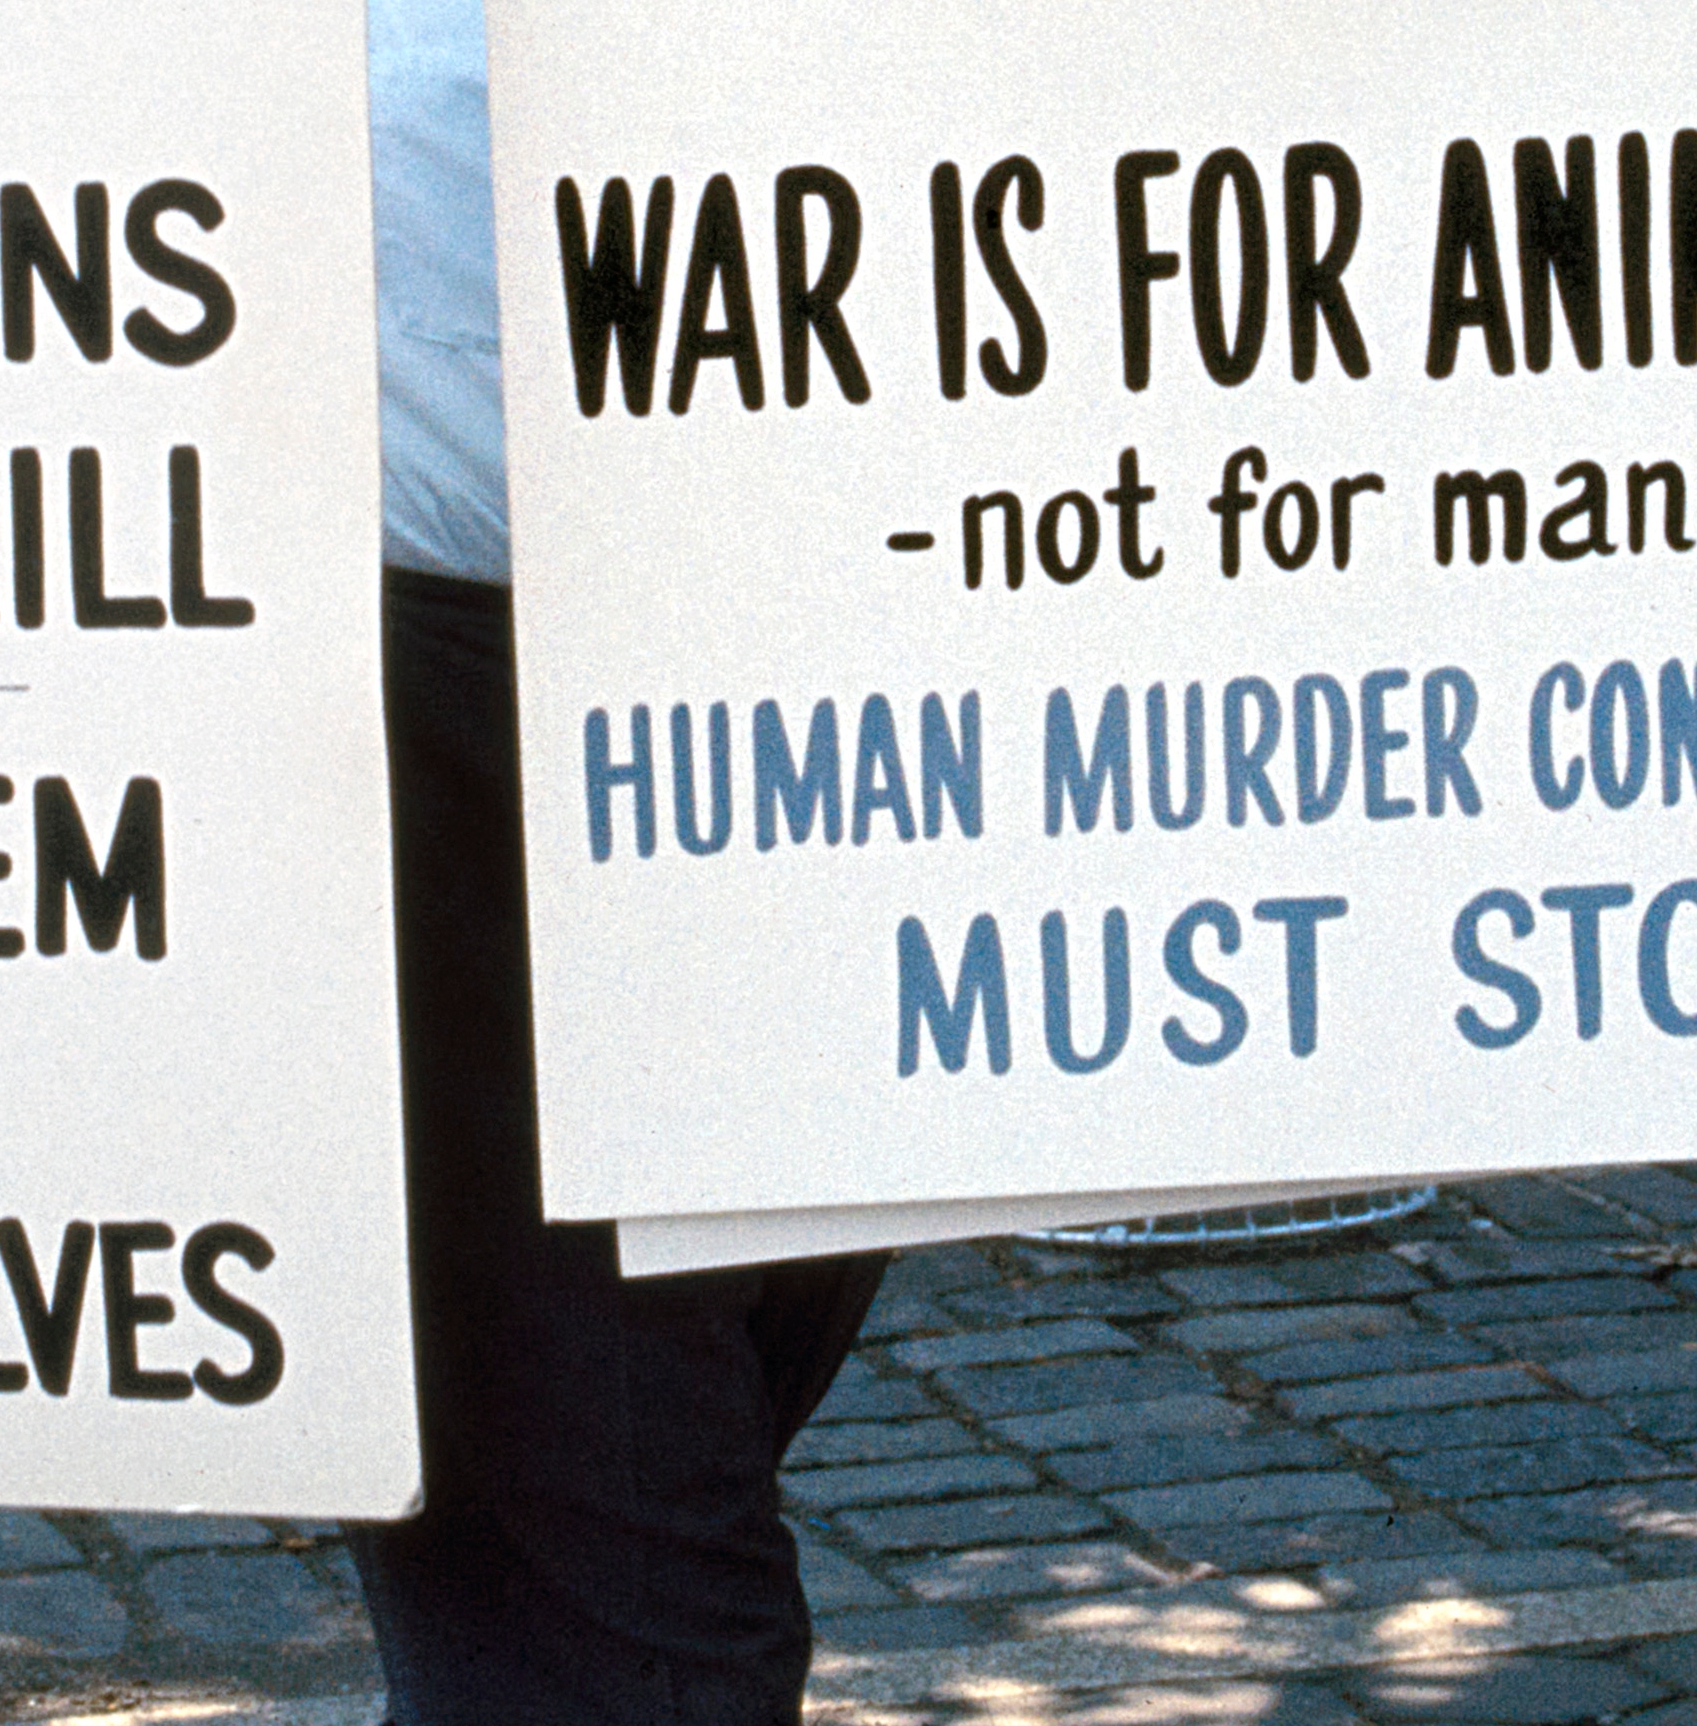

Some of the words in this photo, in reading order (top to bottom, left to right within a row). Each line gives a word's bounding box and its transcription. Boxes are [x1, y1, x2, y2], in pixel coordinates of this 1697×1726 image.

[554, 164, 872, 419] WAR
[929, 154, 1049, 402] IS
[1113, 141, 1371, 394] FOR
[1207, 445, 1386, 580] for
[584, 693, 982, 862] HUMAN
[1045, 668, 1482, 835] MURDER
[897, 897, 1347, 1077] MUST
